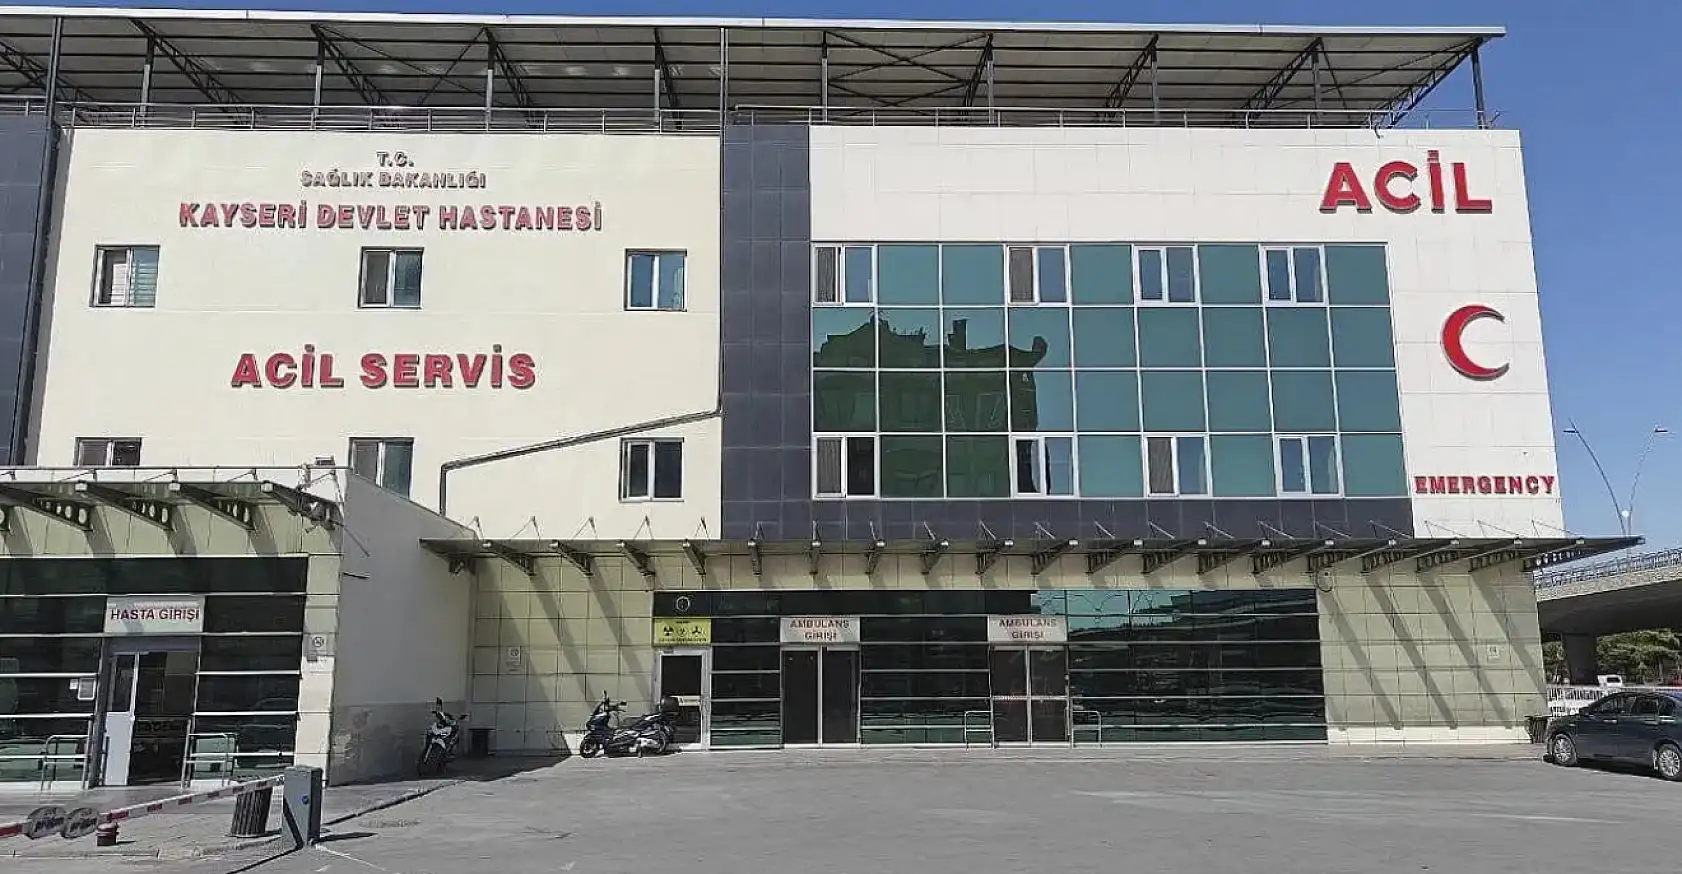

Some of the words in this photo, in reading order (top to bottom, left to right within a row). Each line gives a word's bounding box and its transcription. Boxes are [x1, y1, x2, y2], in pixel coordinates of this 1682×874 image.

[376, 151, 415, 167] T.C.
[300, 168, 374, 188] SAĞLIK
[379, 170, 487, 190] BAKANLIĞI
[1319, 150, 1493, 214] ACİL
[179, 200, 307, 229] KAYSERİ
[316, 204, 430, 230] DEVLET
[438, 201, 602, 231] HASTANESİ
[231, 344, 344, 388] ACİL
[359, 344, 536, 390] SERVİS
[1414, 475, 1555, 495] EMERGENCY
[111, 608, 155, 621] HASTA
